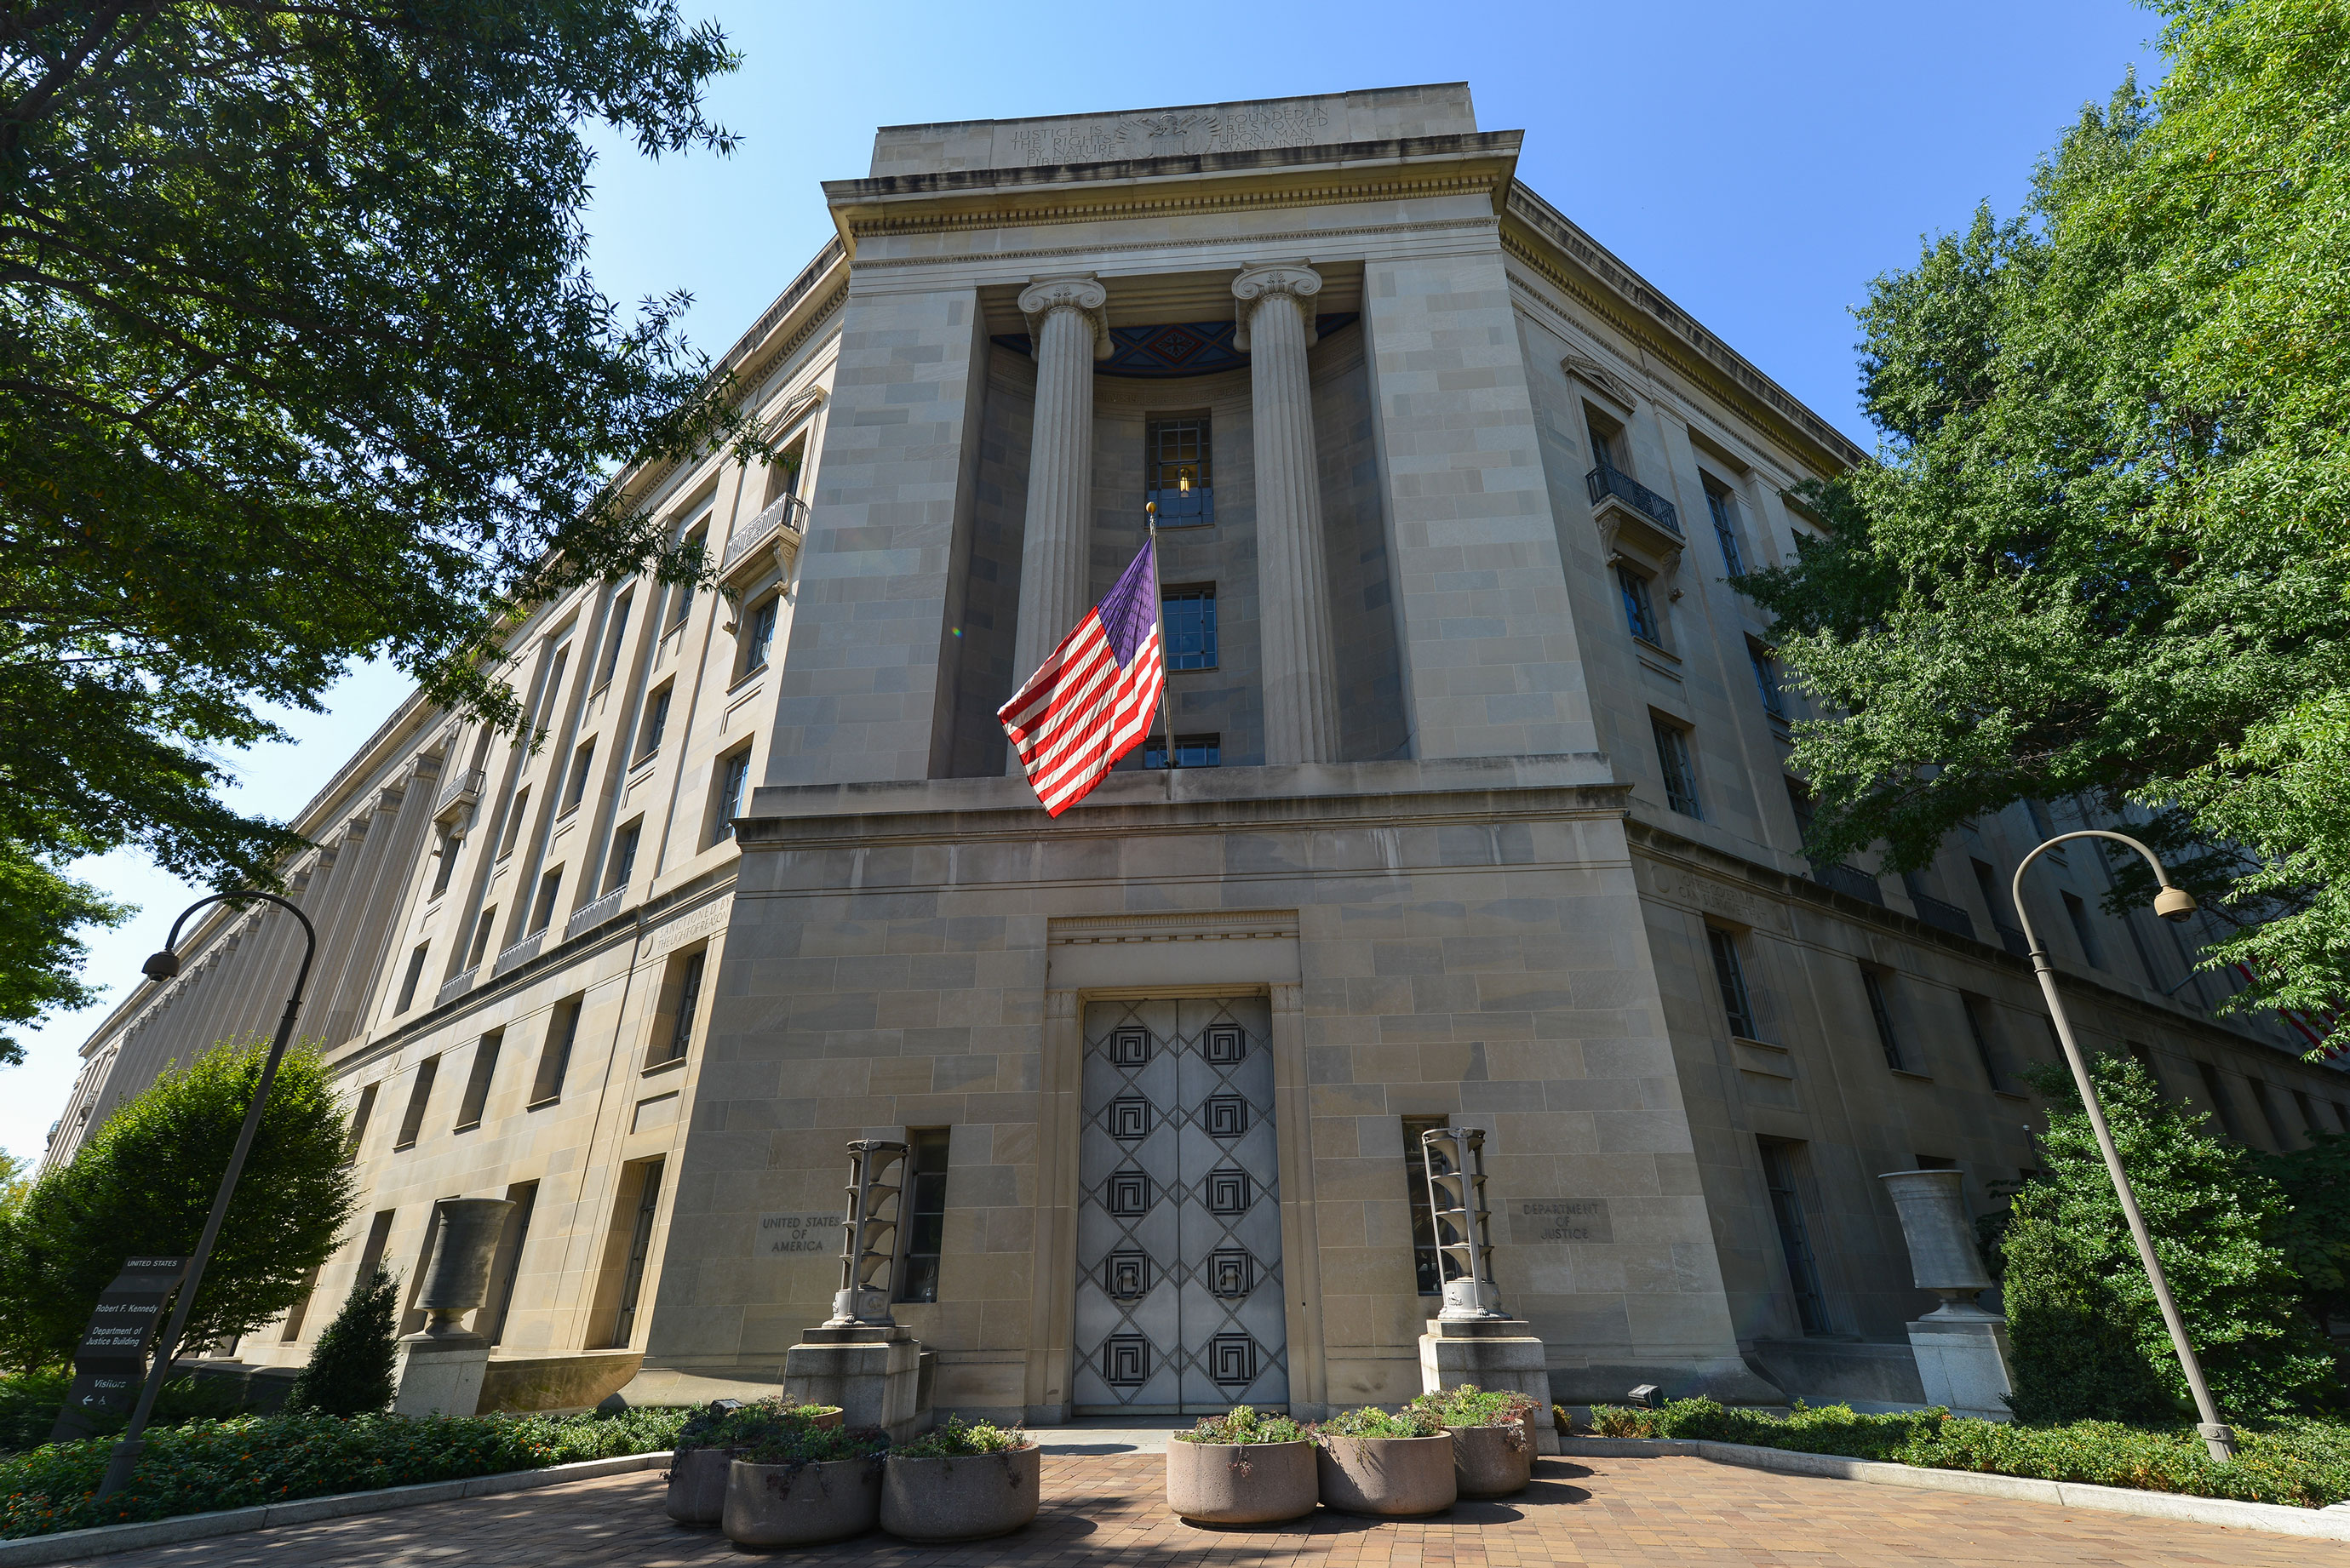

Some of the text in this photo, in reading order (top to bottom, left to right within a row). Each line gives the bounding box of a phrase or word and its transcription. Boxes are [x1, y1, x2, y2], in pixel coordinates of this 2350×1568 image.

[1010, 107, 1328, 141] JUSTICE IS FOUNDED IN
[1011, 117, 1328, 151] THE RIGHTS BESTOWED
[1027, 148, 1046, 159] BY
[1053, 143, 1117, 157] NATURE
[1218, 131, 1264, 144] UPON
[1101, 152, 1115, 161] IS
[1218, 137, 1315, 152] MAINTAINED
[719, 896, 732, 911] BY
[1523, 1204, 1598, 1215] DEPARTMENT
[762, 1216, 840, 1229] UNITED STATES
[1556, 1216, 1570, 1227] OF
[792, 1229, 807, 1239] OF
[1541, 1228, 1590, 1240] JUSTICE
[771, 1240, 823, 1253] AMERICA
[128, 1304, 158, 1313] Kennedy
[93, 1326, 142, 1336] Department of
[86, 1337, 140, 1347] Justice Building
